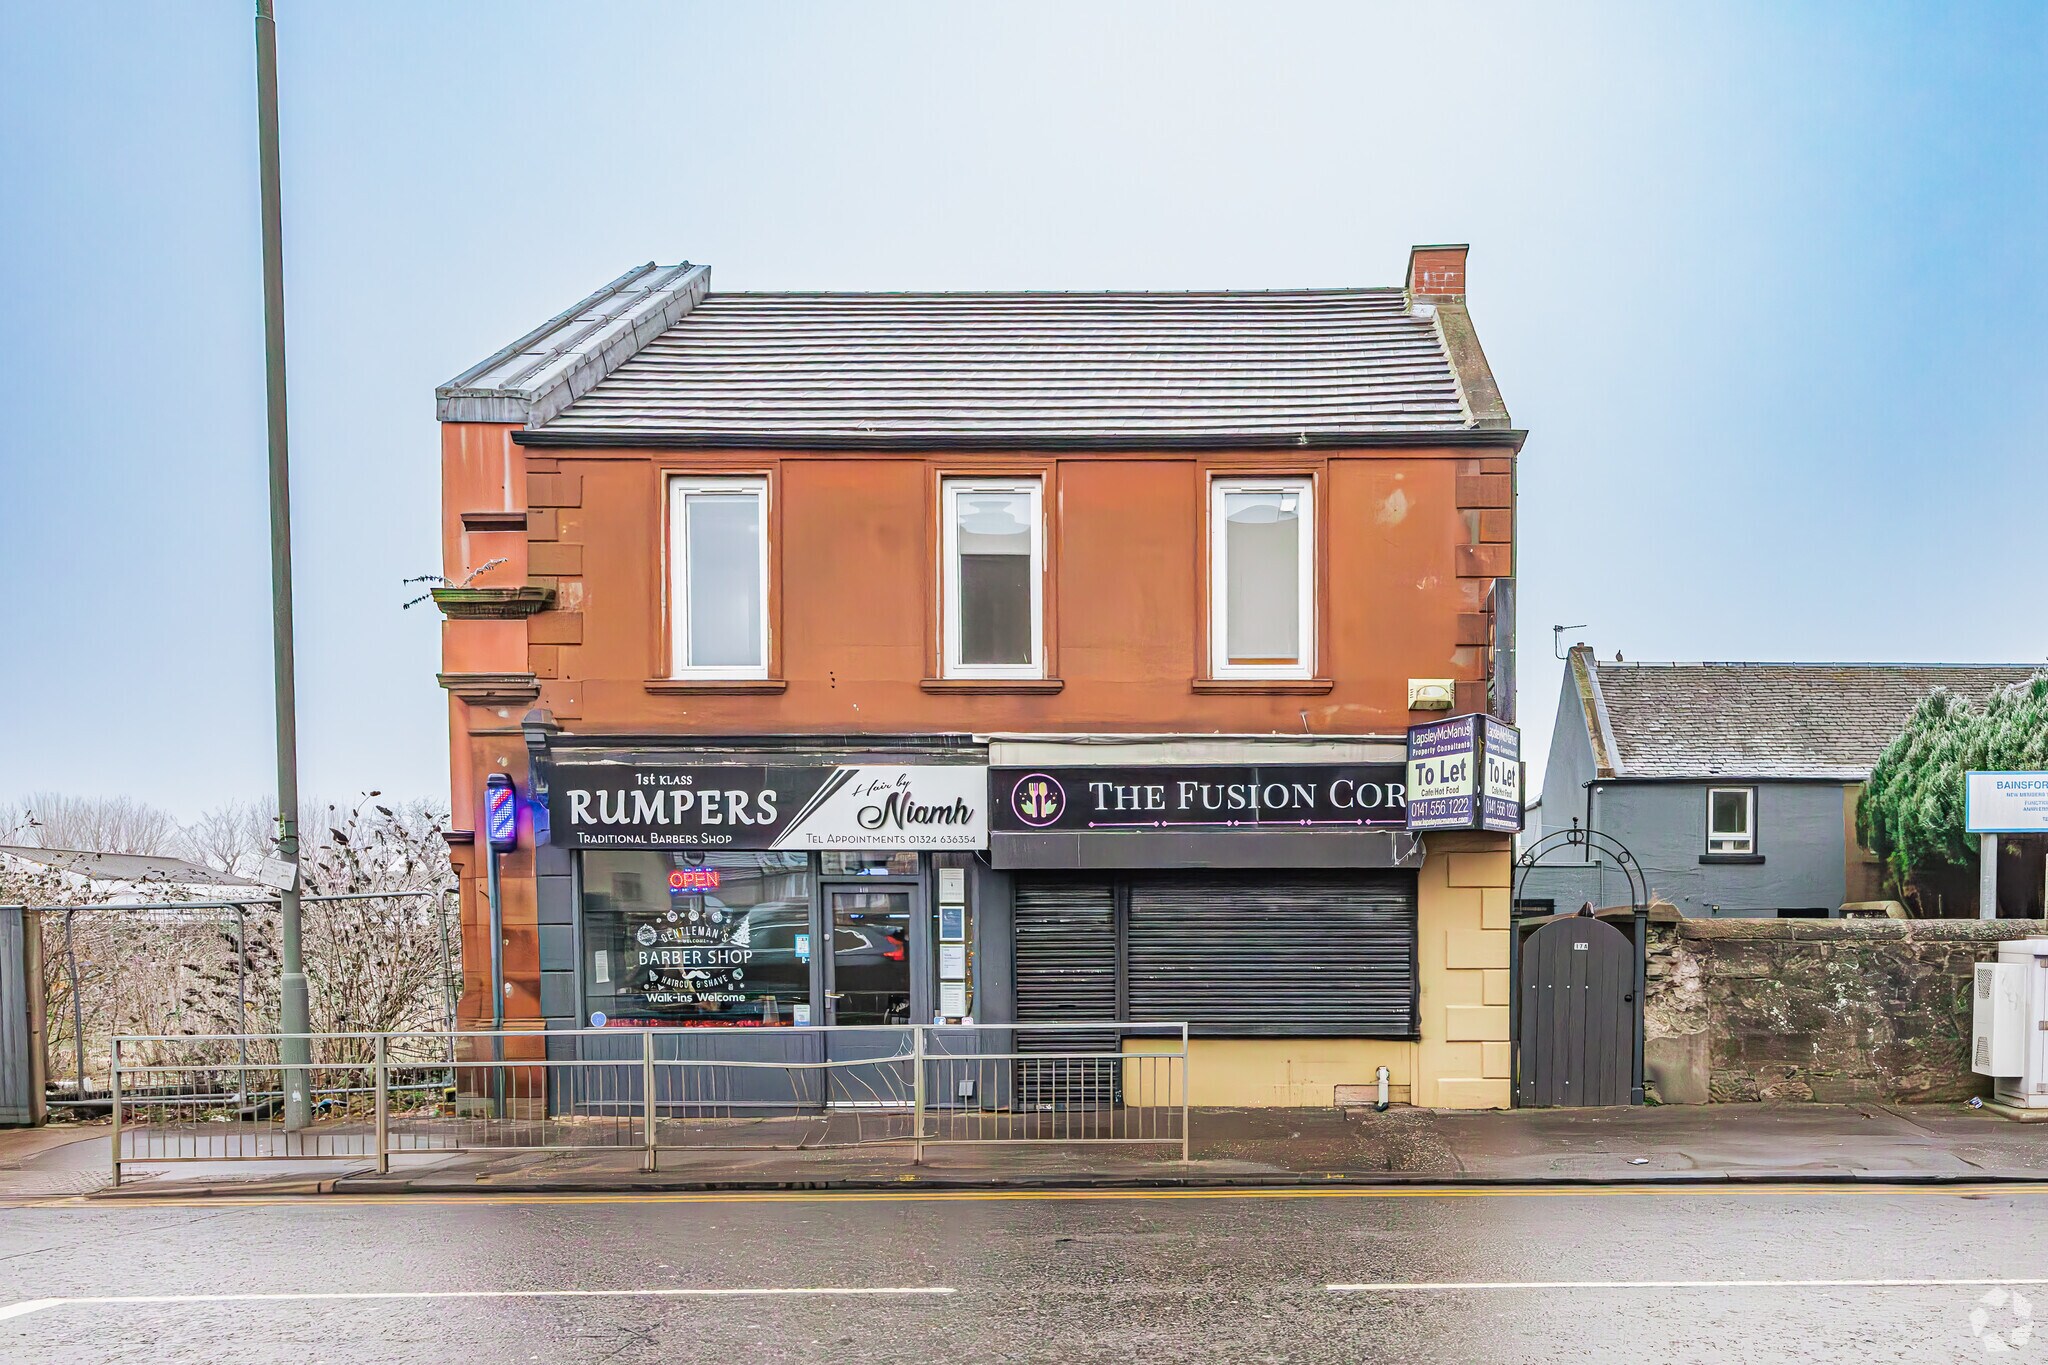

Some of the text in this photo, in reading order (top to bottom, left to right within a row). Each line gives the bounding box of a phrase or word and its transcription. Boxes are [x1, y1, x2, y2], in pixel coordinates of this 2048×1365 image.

[1412, 741, 1470, 756] Property Consultants
[635, 773, 693, 786] 1st KLASS
[1416, 758, 1466, 786] To Let
[1489, 758, 1516, 788] To Let
[852, 773, 912, 797] Hair by
[1421, 785, 1460, 797] Cafe Hot Food
[1996, 780, 2048, 790] BAINSFOR
[1088, 779, 1406, 811] THE FUSION COR
[566, 789, 778, 826] RUMPERS
[856, 791, 974, 831] Niamh
[1411, 801, 1429, 818] 0141
[1448, 797, 1469, 814] 1222
[577, 832, 733, 844] TRADITIONAL BARBERS SHOP
[806, 833, 976, 844] TEL APPOINTMENTS 01324 636354
[669, 871, 719, 888] OPEN
[661, 925, 729, 943] GENTLEMAN'S
[638, 949, 753, 966] BARBER SHOP
[661, 974, 729, 989] HAIRCUT & SHAVE
[646, 993, 746, 1003] Walk-ins Welcome
